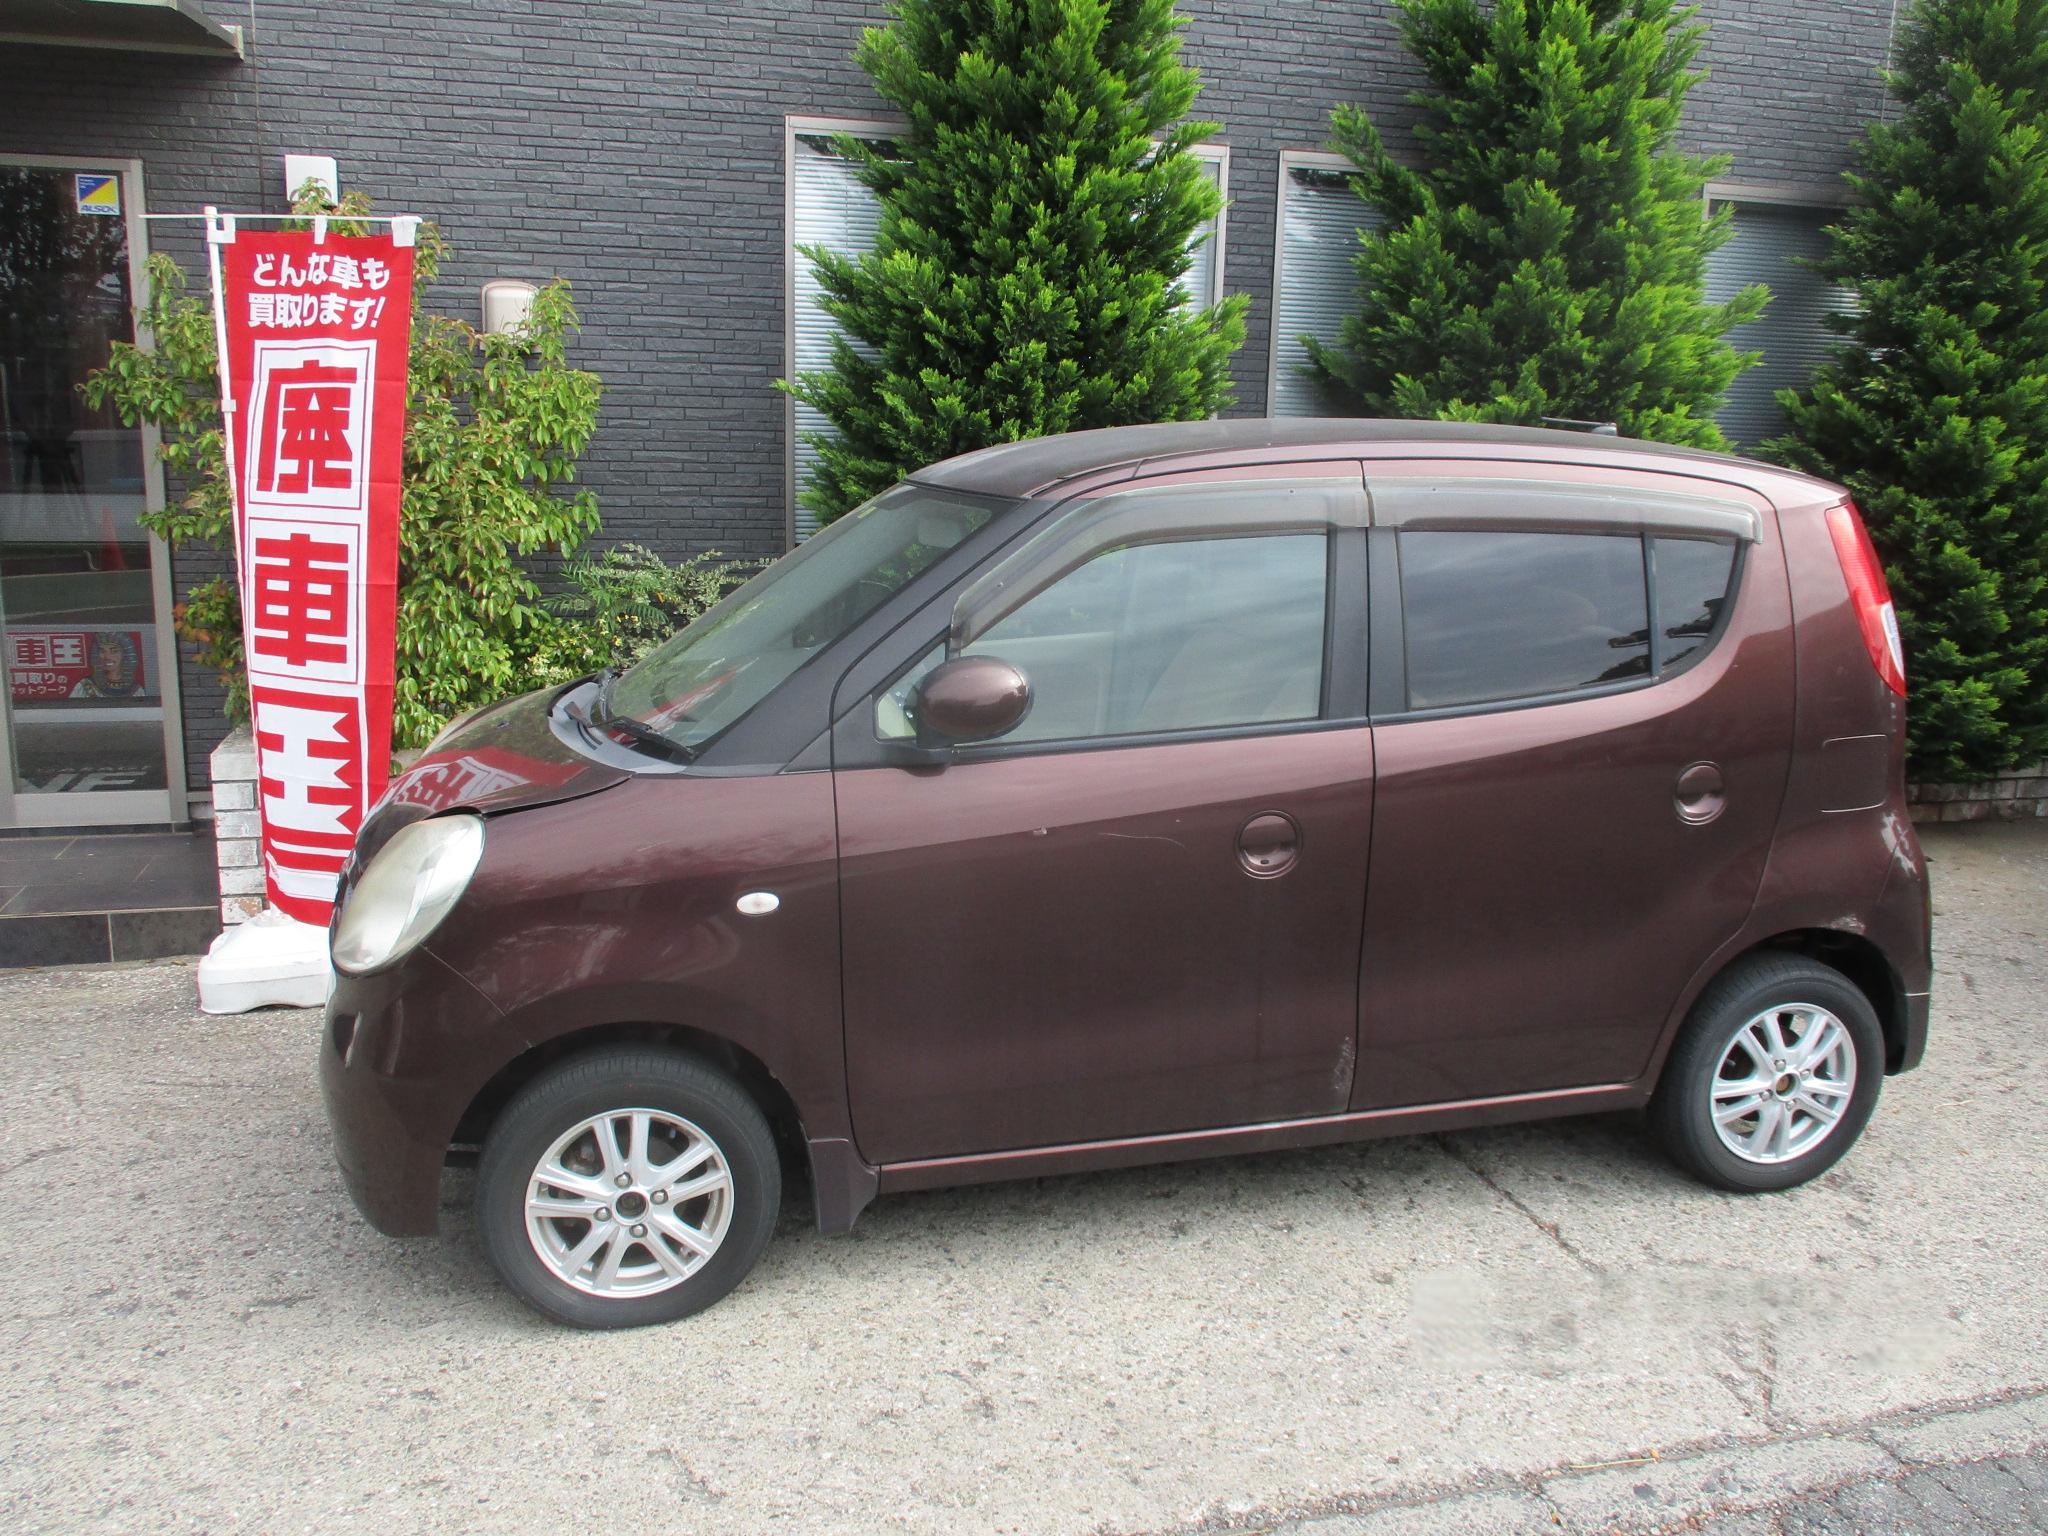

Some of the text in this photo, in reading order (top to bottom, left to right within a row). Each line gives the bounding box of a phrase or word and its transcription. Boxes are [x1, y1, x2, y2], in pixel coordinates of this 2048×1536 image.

[253, 252, 390, 290] どんな車も
[248, 292, 386, 330] 買取ります!
